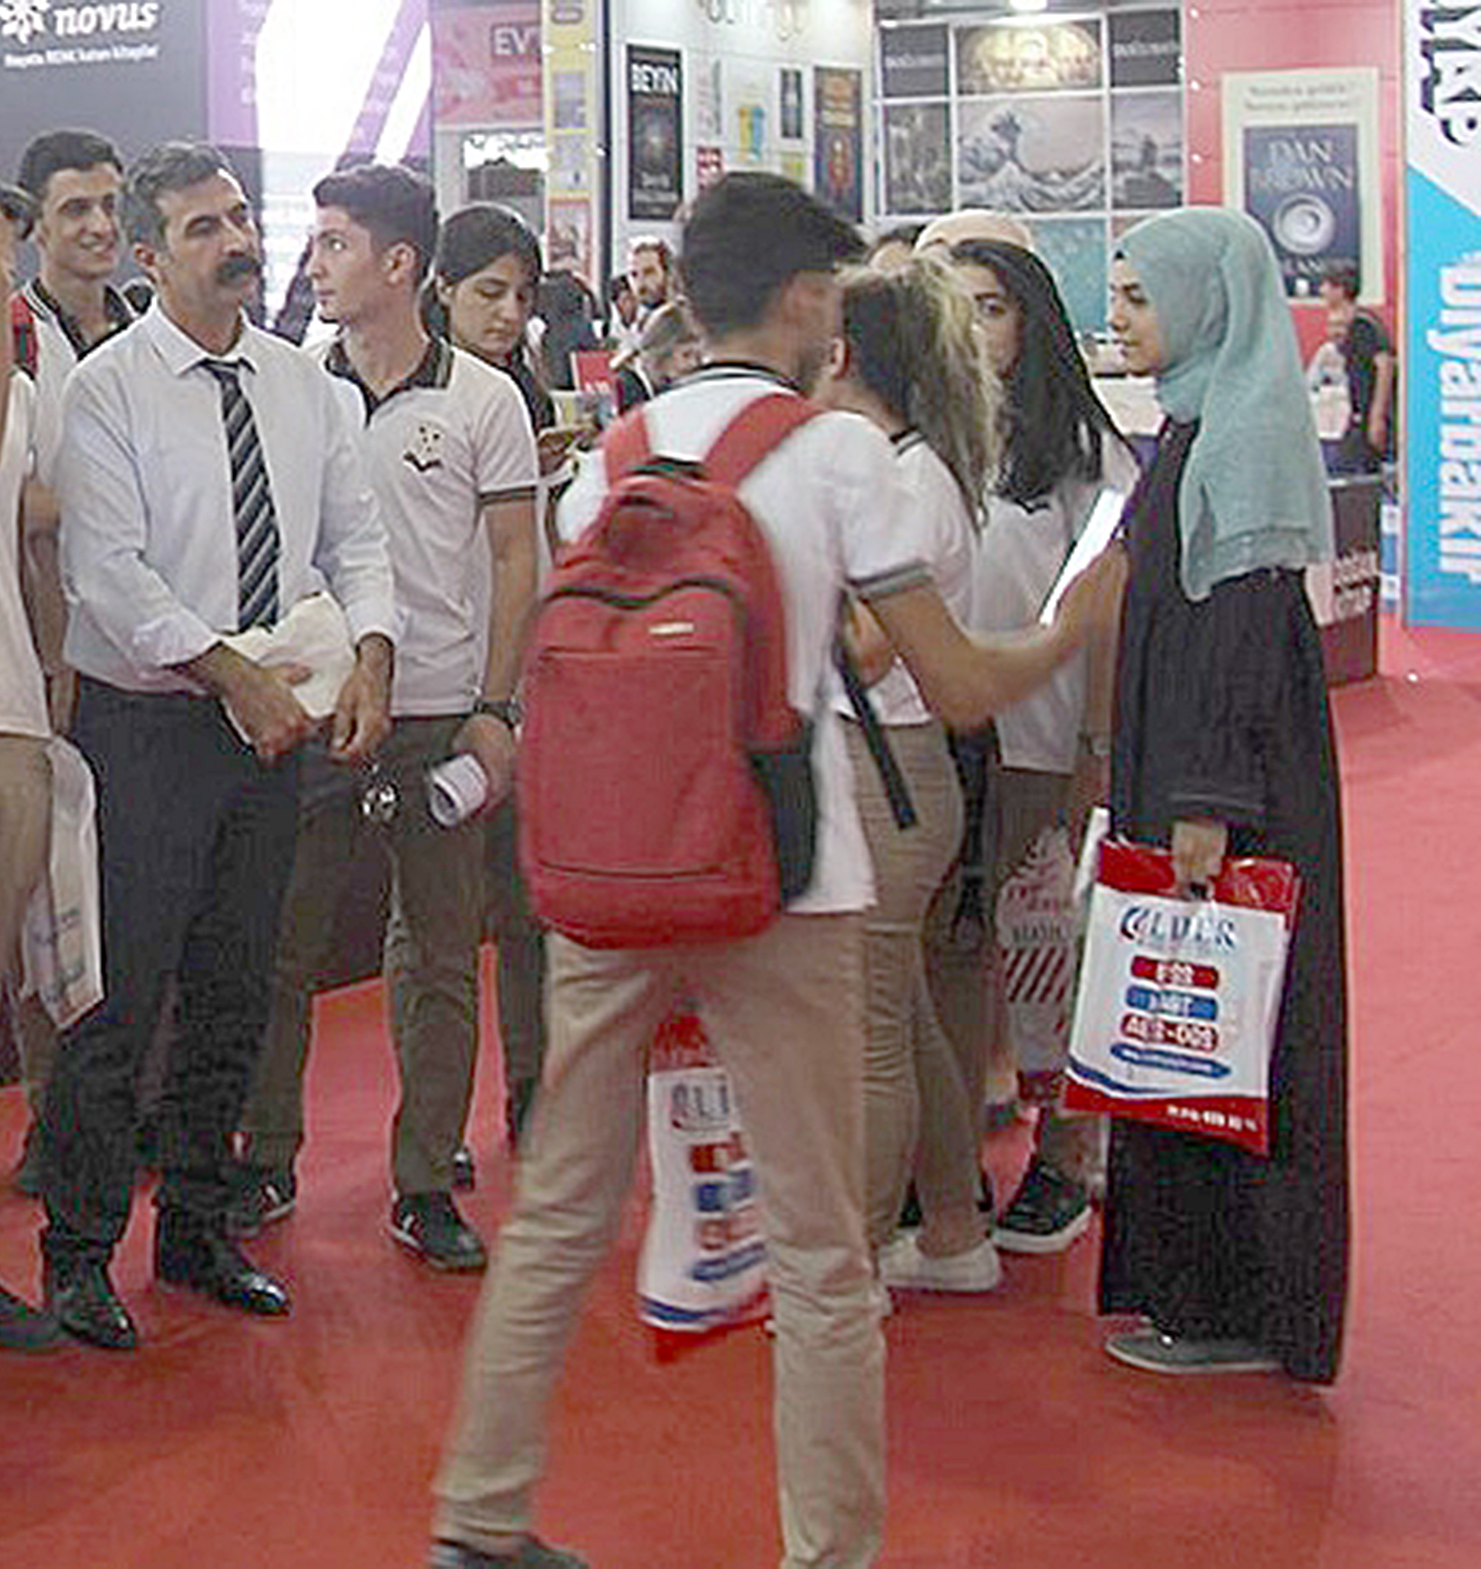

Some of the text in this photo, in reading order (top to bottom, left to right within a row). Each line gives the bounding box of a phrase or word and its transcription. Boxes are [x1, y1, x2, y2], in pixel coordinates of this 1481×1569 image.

[53, 2, 159, 36] novus
[1421, 0, 1481, 146] YAP
[1268, 137, 1333, 164] DAN
